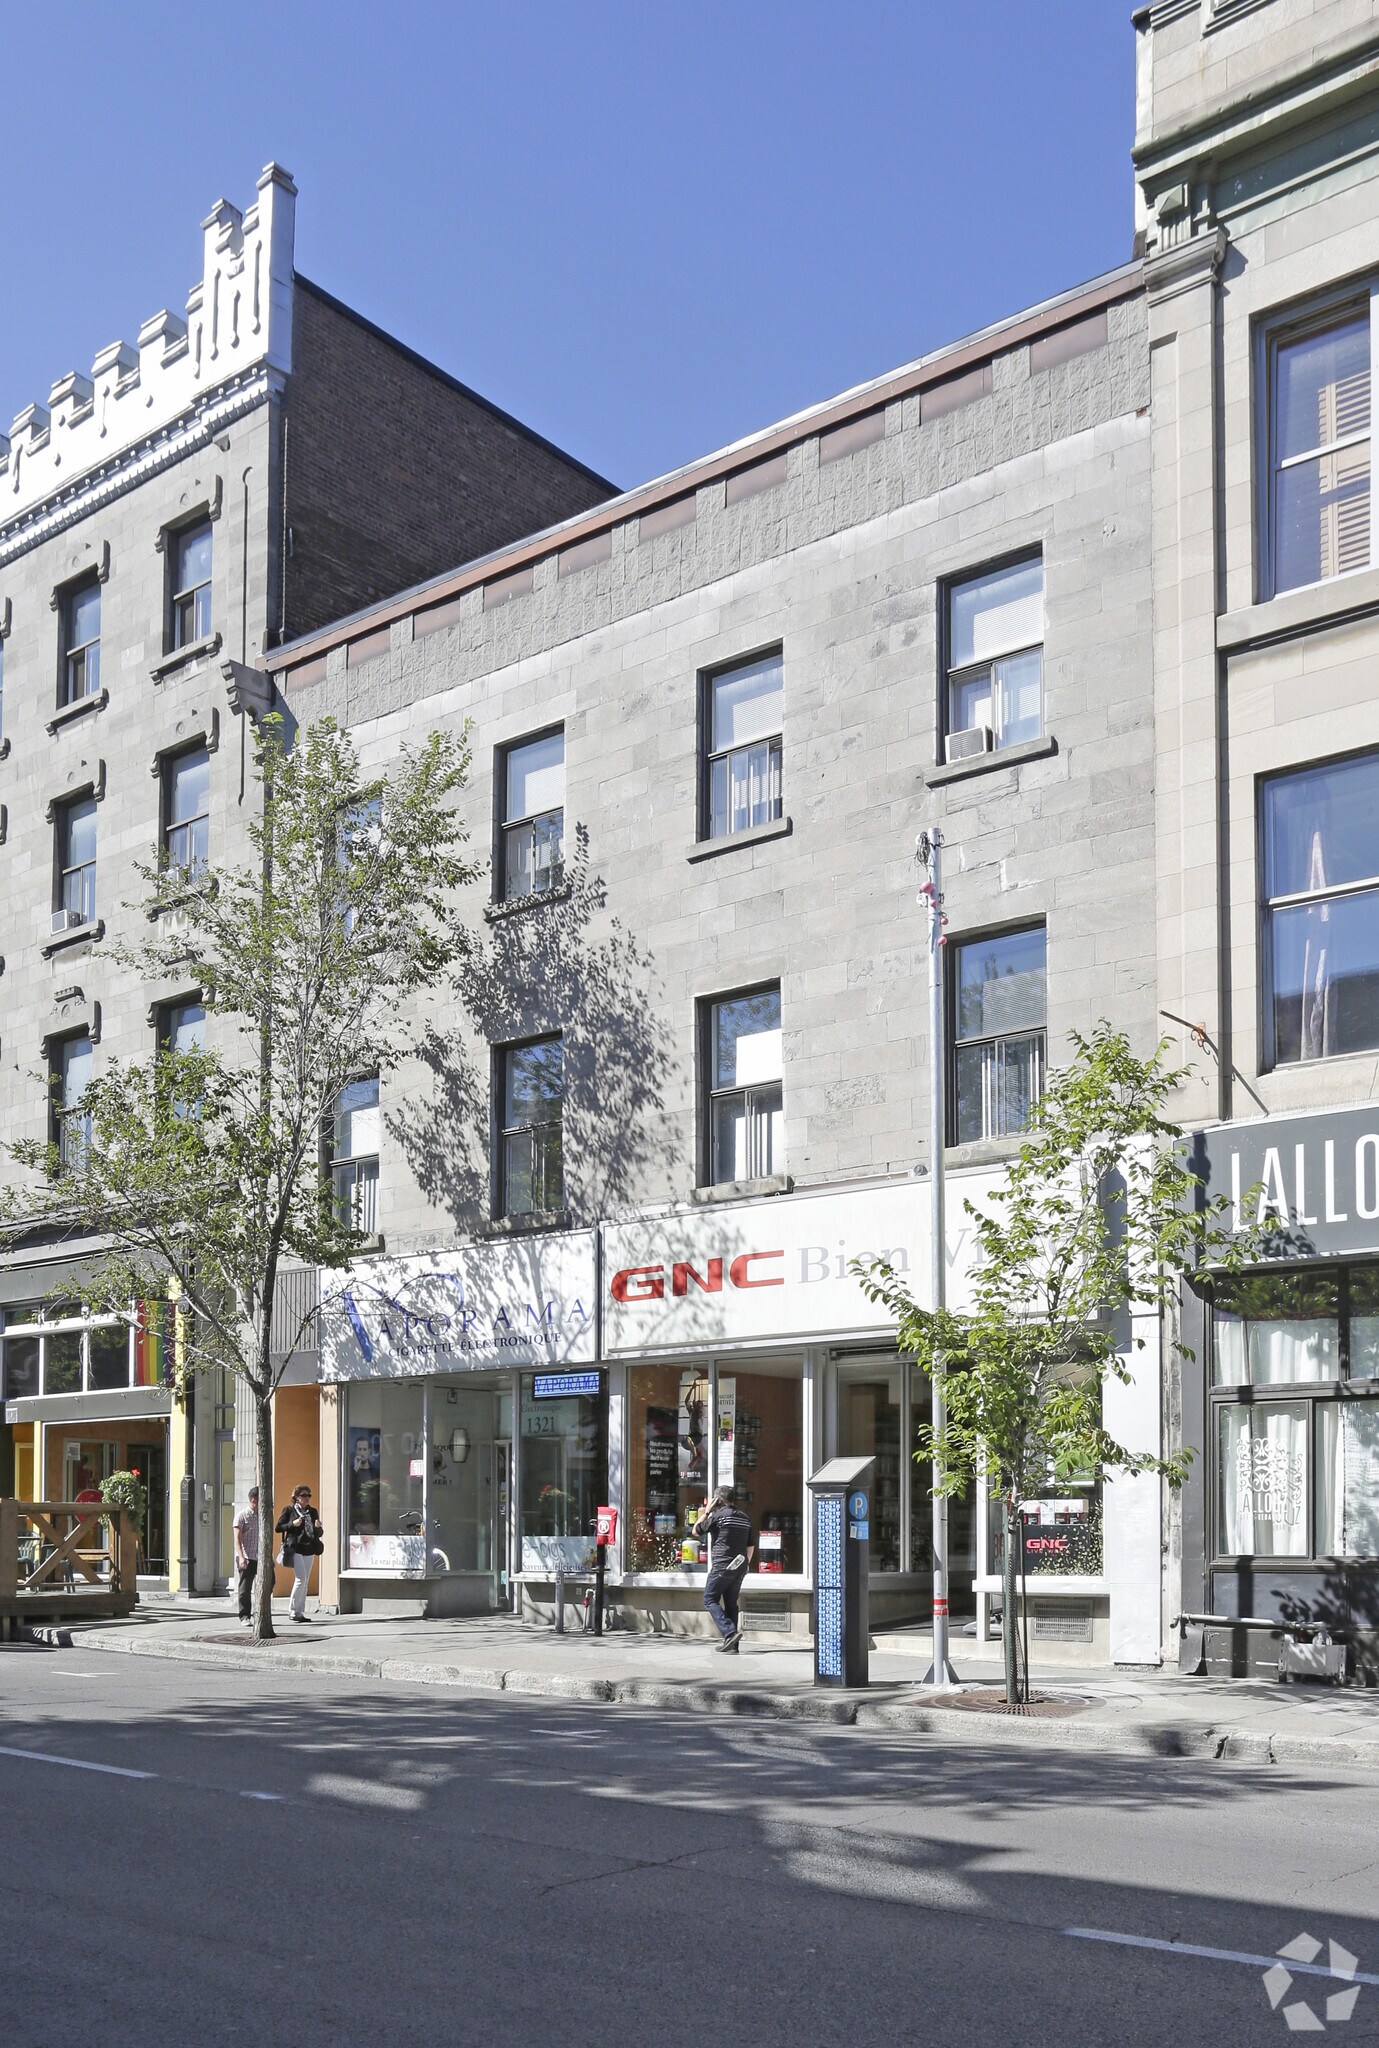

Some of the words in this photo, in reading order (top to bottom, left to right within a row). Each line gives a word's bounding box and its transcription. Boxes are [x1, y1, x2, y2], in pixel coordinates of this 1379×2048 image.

[610, 1249, 785, 1303] GNC
[797, 1244, 910, 1285] Bien
[324, 1273, 590, 1363] VAPORAMA
[388, 1340, 455, 1359] CIGARETTE
[460, 1331, 563, 1351] ÉLECTRONIQUE
[527, 1416, 556, 1434] 1321
[522, 1542, 566, 1561] e-cigs
[1026, 1538, 1068, 1549] GNC
[522, 1561, 548, 1571] Saveurs
